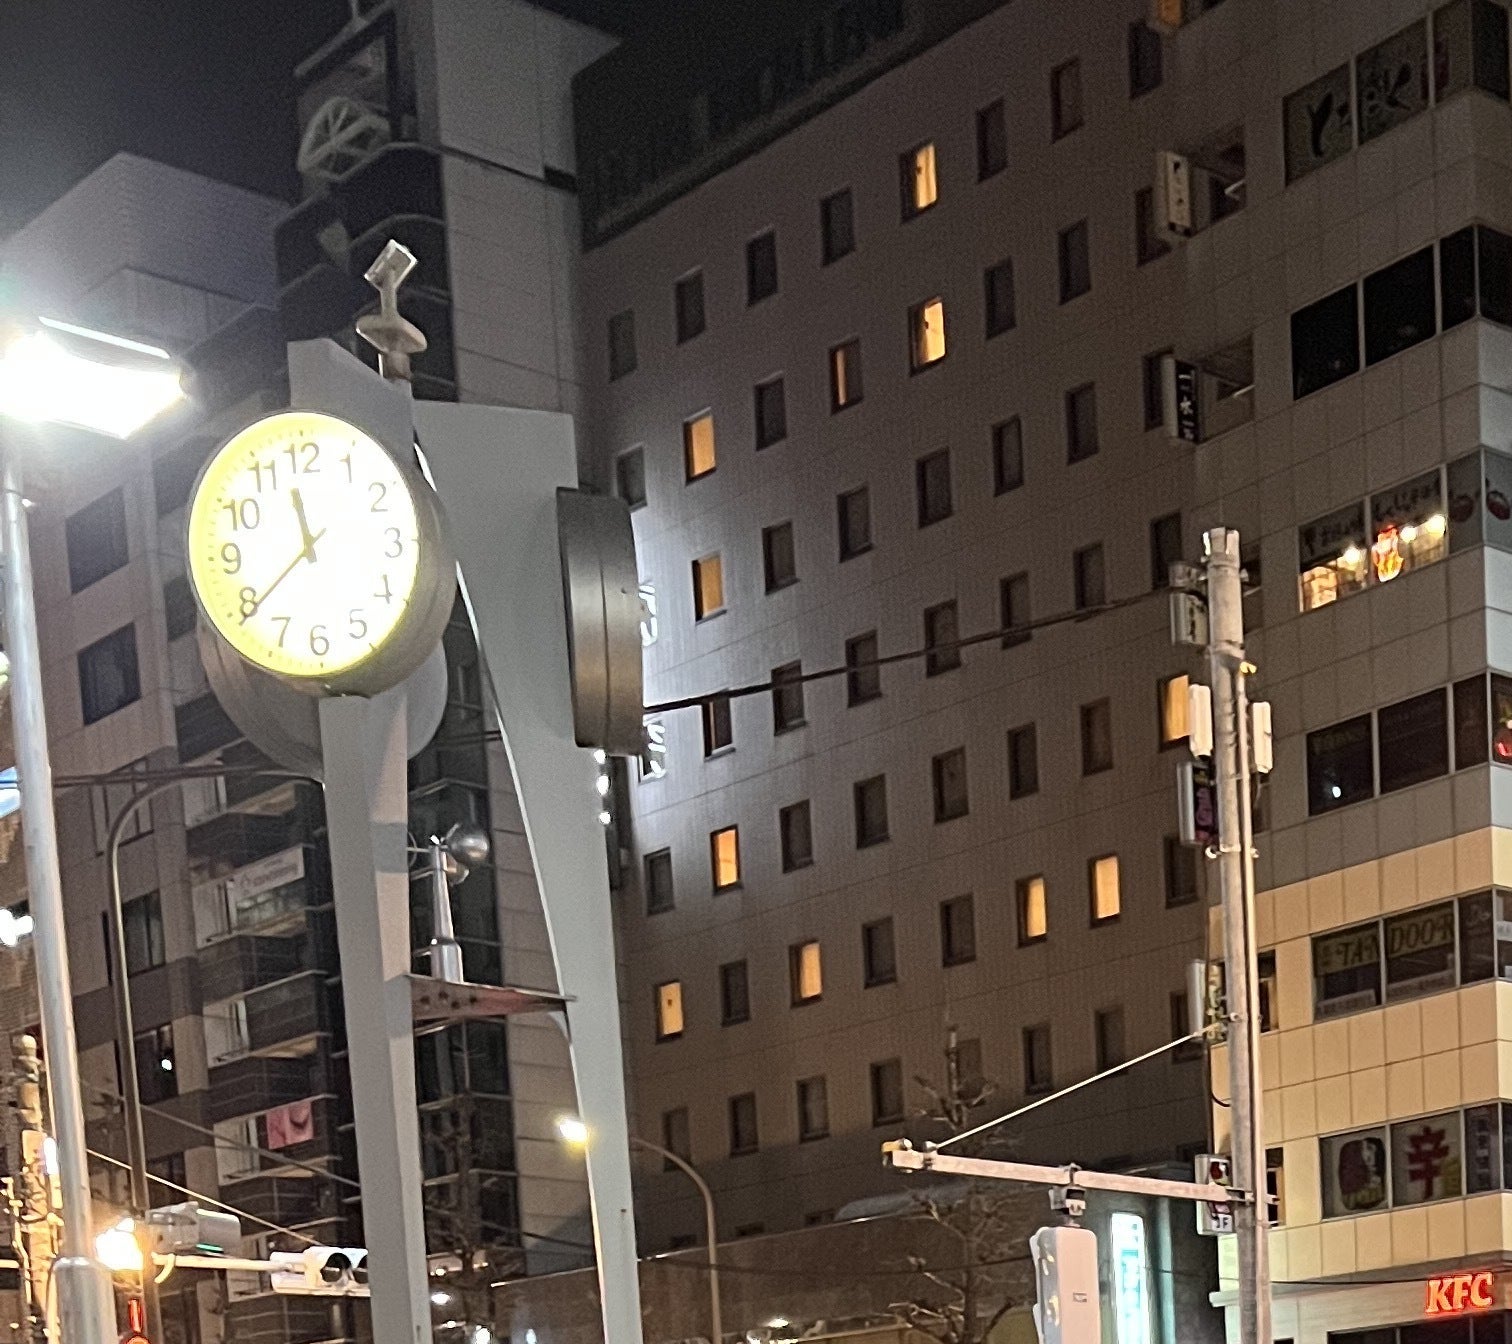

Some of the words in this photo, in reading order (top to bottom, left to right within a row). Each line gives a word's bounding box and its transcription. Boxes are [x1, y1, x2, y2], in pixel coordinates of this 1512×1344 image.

[283, 442, 321, 475] 12
[339, 454, 353, 483] 1
[247, 459, 277, 493] 11
[368, 481, 388, 512] 2
[222, 498, 260, 531] 10
[220, 542, 242, 575] 9
[383, 527, 403, 558] 3
[239, 586, 258, 618] 8
[373, 574, 393, 604] 4
[271, 616, 291, 648] 7
[310, 624, 330, 656] 6
[348, 608, 368, 640] 5
[1425, 1271, 1493, 1315] KFC
